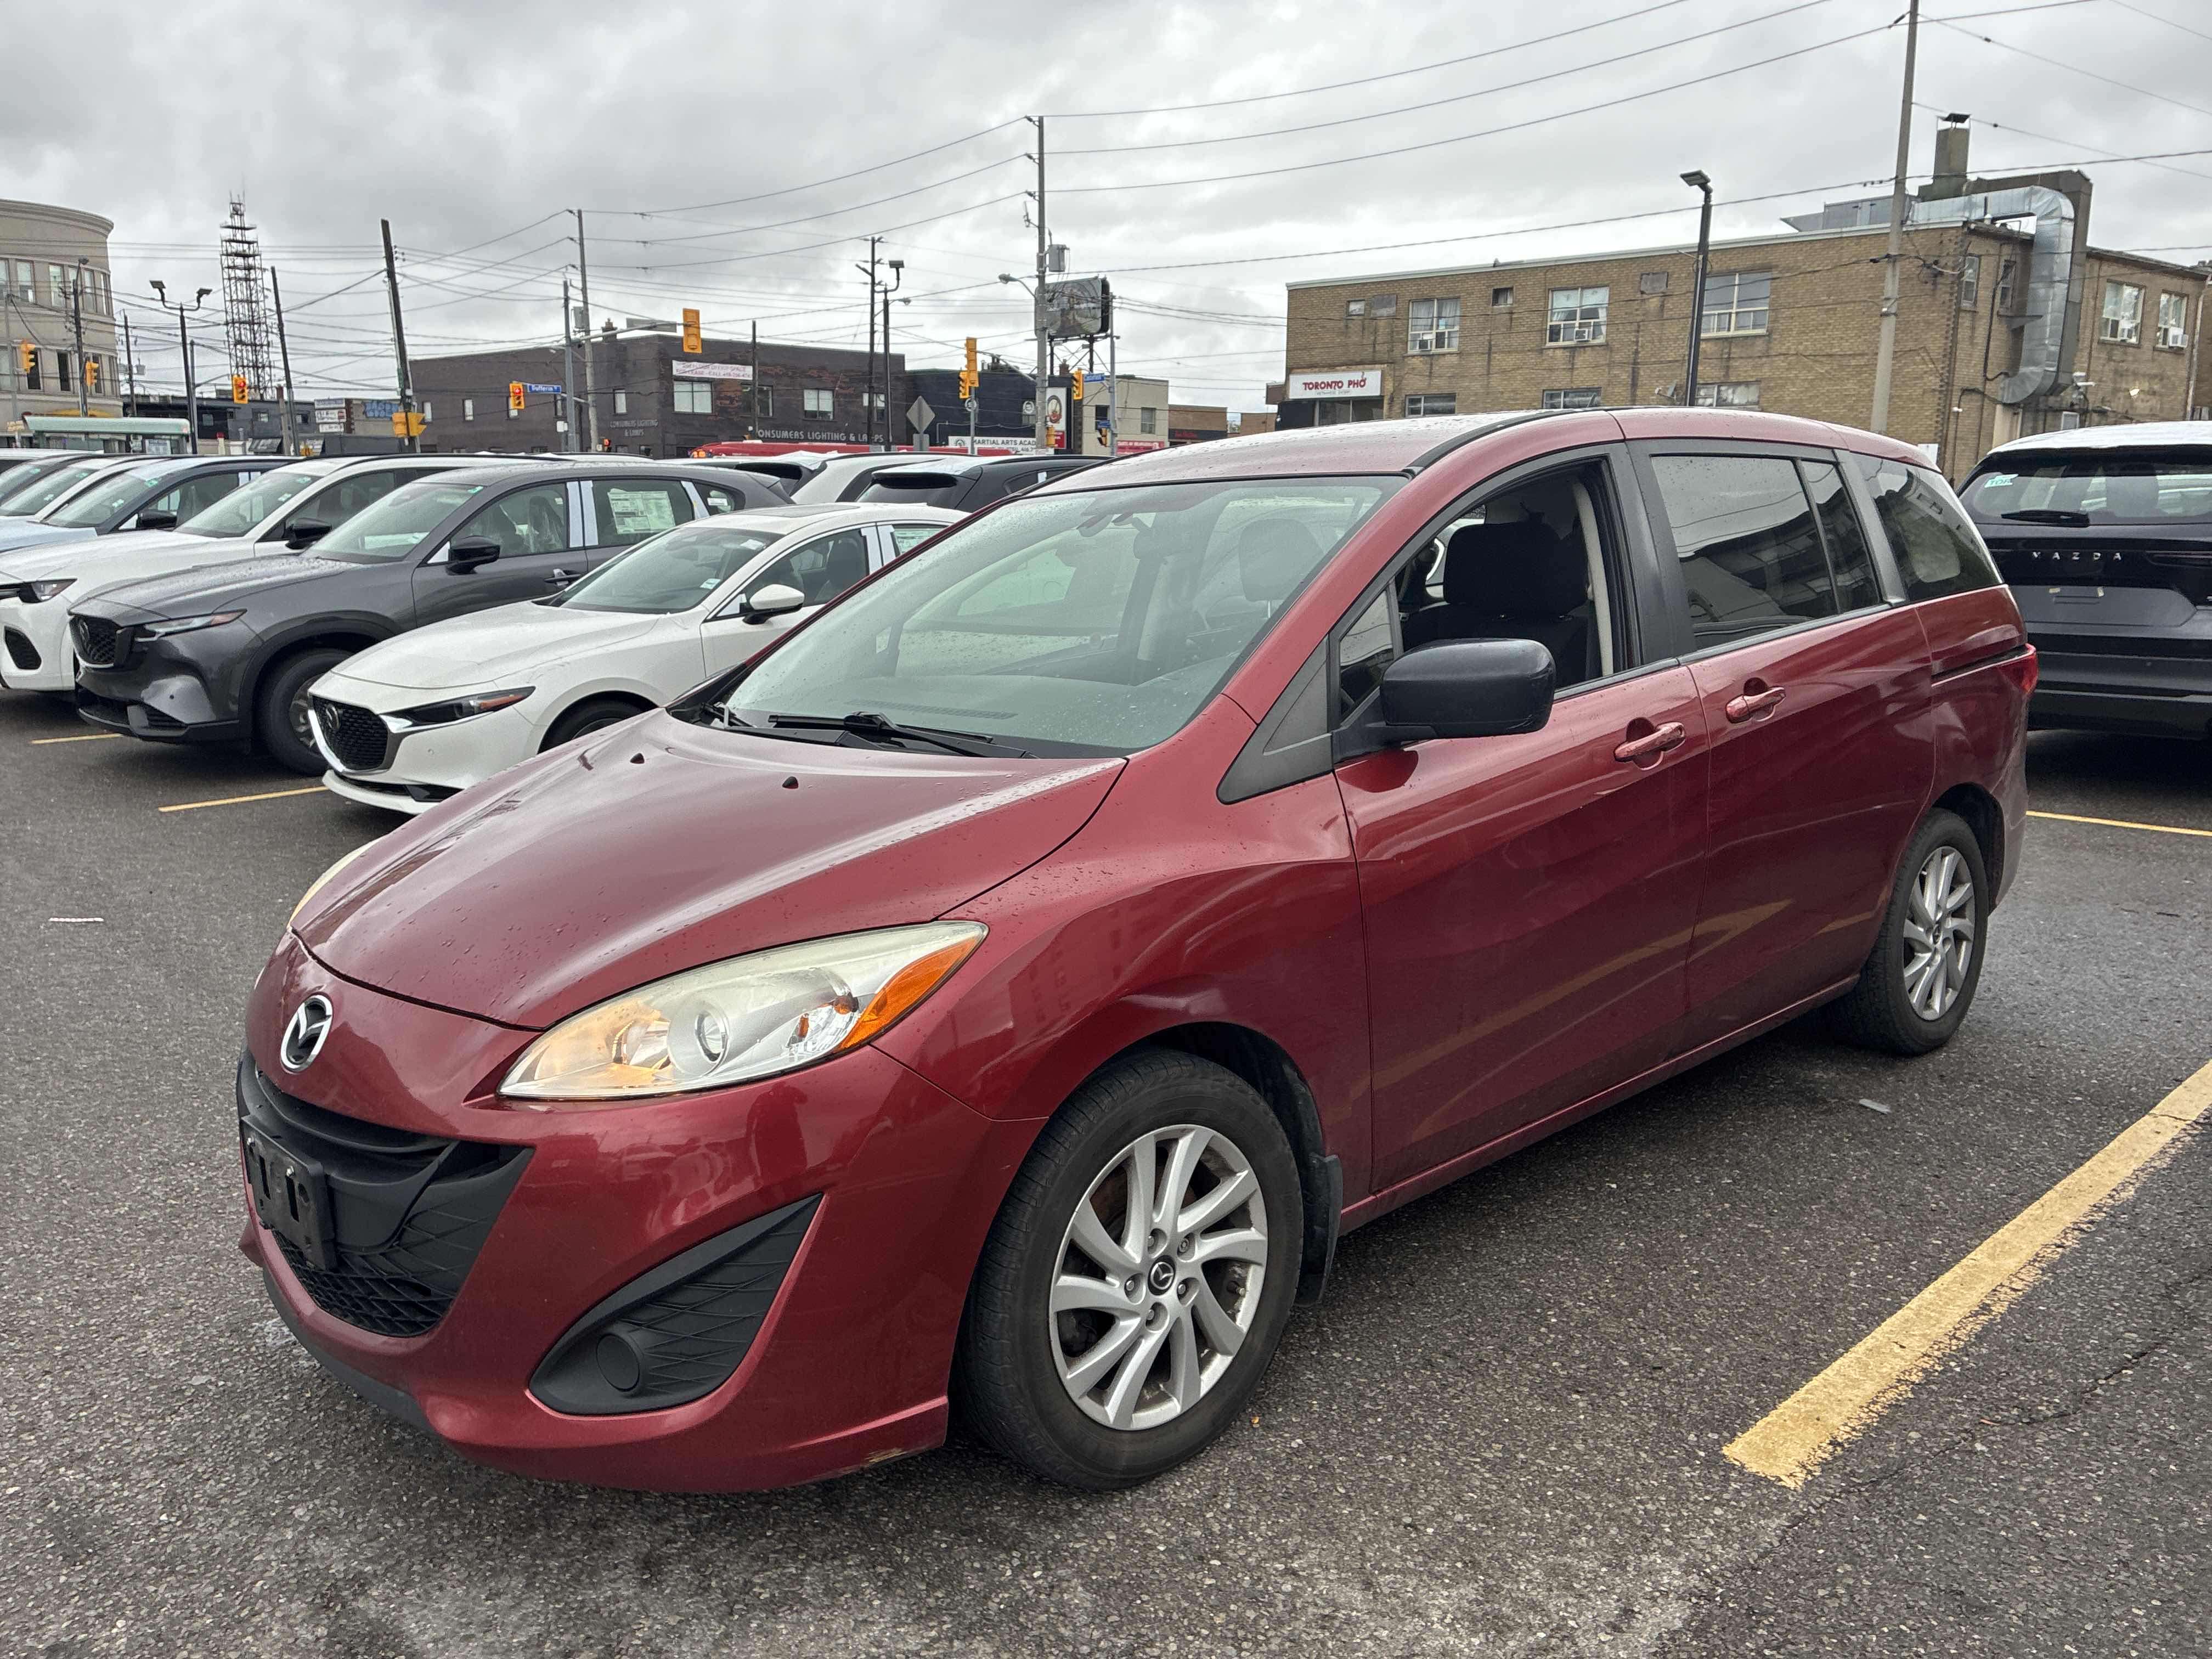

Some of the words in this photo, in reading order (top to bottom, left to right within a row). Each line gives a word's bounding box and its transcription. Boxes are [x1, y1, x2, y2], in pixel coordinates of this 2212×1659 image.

[1302, 380, 1344, 391] TORONTO
[757, 430, 804, 439] ONSUMERS
[807, 431, 847, 442] LIGHTING
[858, 433, 884, 443] LAPS
[2032, 551, 2122, 561] MAZDA
